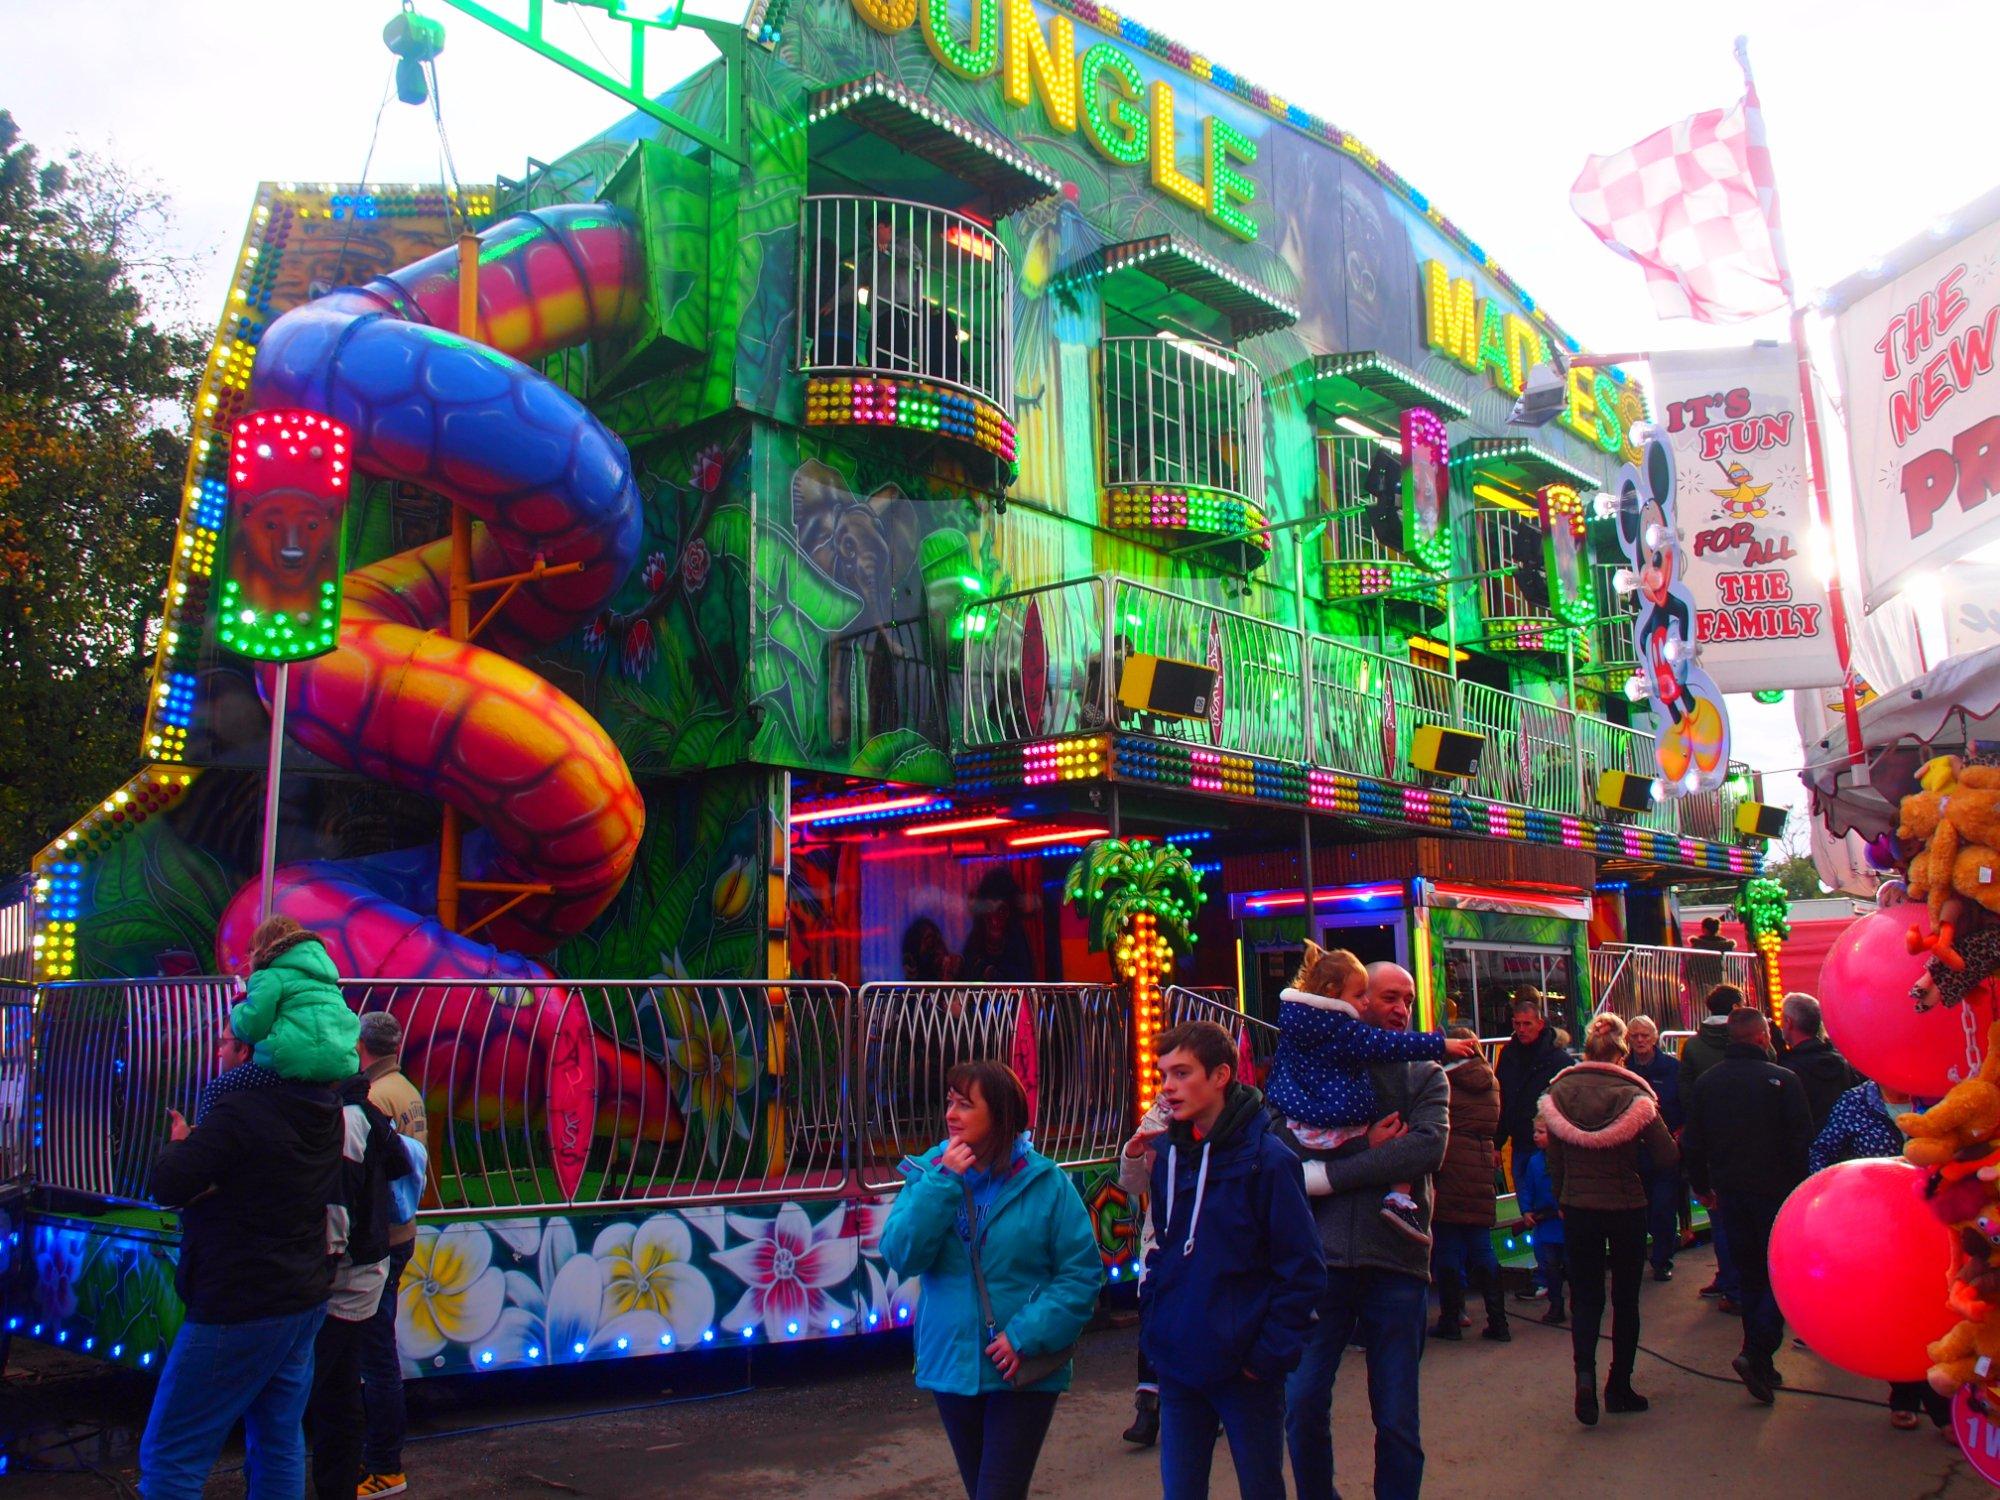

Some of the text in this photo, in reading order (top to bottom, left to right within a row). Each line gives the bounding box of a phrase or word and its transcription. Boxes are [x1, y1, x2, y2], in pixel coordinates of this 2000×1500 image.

[855, 0, 1259, 243] UNGLE
[1875, 263, 1969, 382] THE
[1888, 304, 2000, 448] NEW
[1666, 387, 1751, 434] IT'S
[1699, 411, 1794, 461] FUN
[1694, 522, 1797, 568] FOR ALL
[1716, 570, 1792, 605] THE
[1695, 603, 1822, 643] FAMILY
